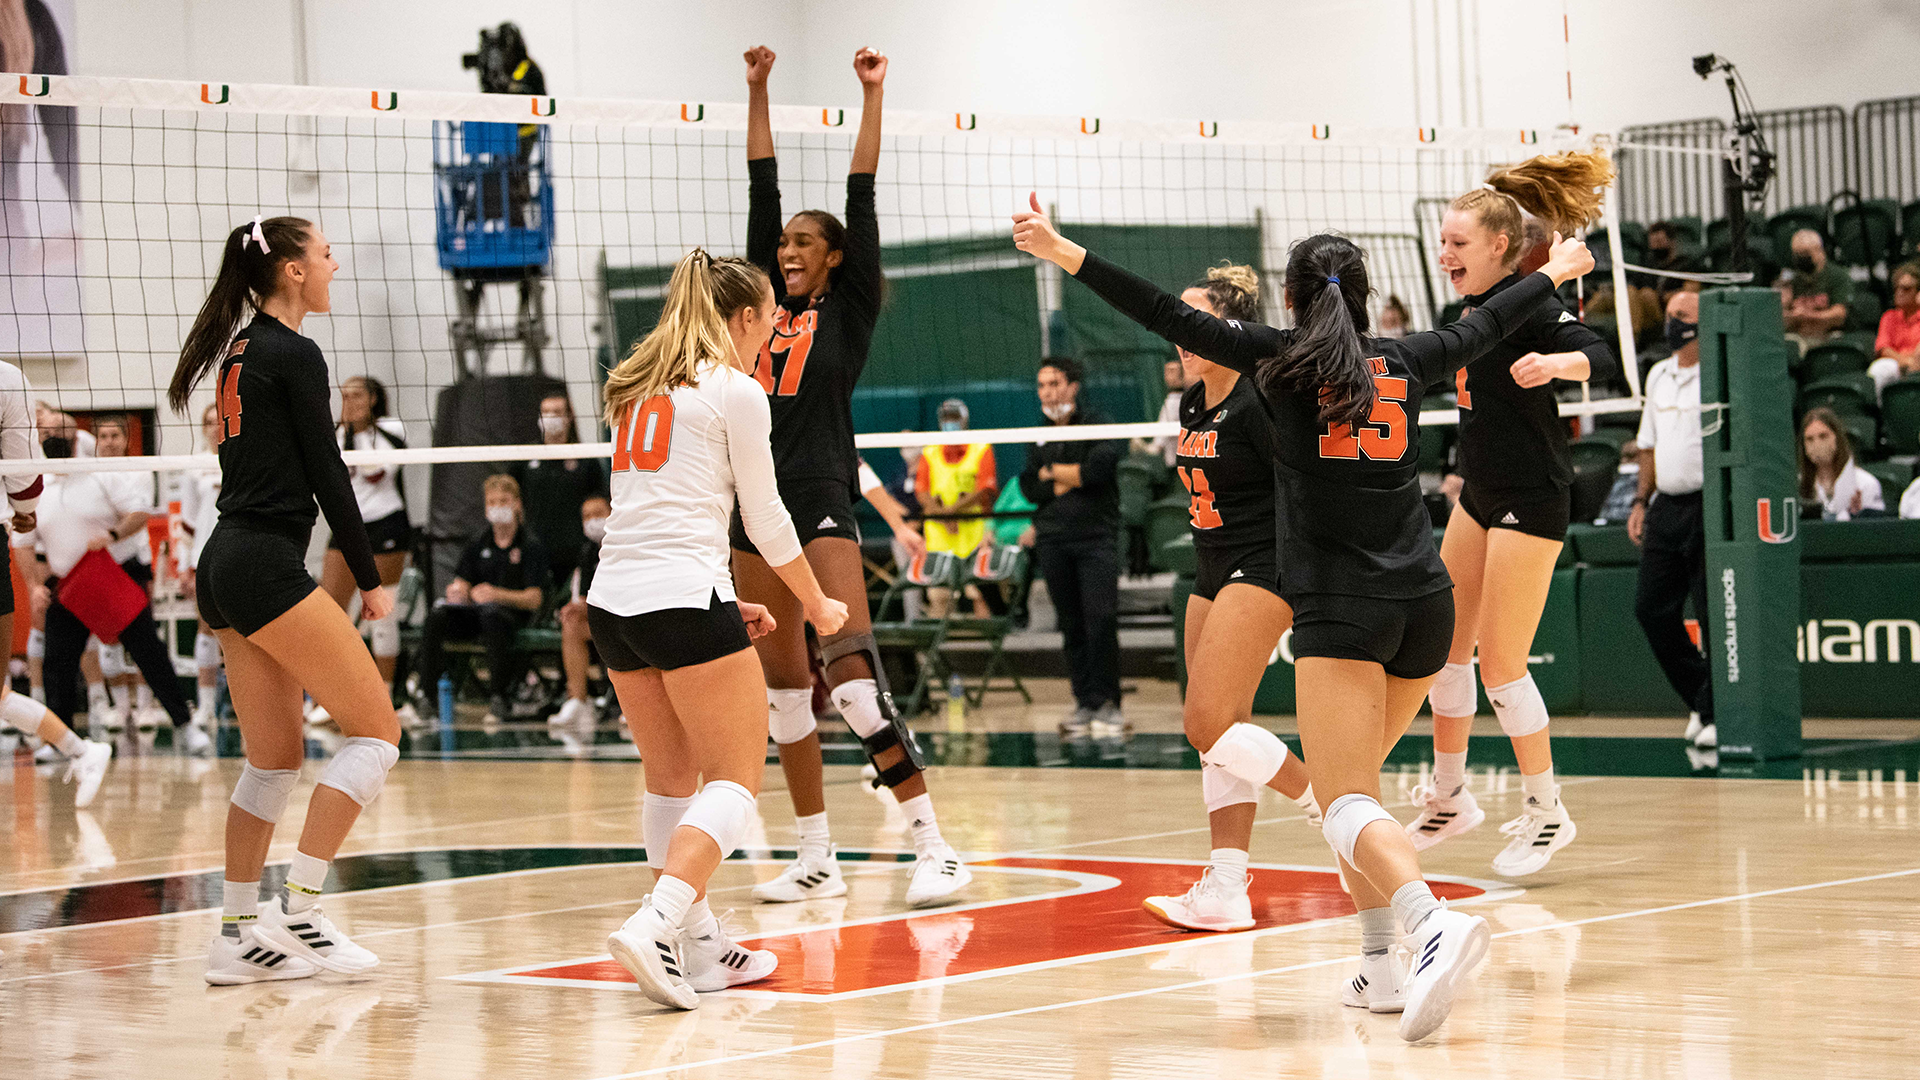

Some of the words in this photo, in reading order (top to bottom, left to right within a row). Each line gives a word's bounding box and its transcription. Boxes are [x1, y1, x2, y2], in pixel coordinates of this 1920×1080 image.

[19, 76, 49, 96] U
[201, 84, 229, 104] U
[371, 91, 398, 111] U
[531, 98, 556, 116] U
[681, 104, 704, 122] U
[822, 109, 844, 127] U
[956, 113, 976, 130] U
[1081, 118, 1099, 135] U
[1200, 122, 1218, 137] U
[1312, 125, 1330, 140] U
[1419, 128, 1435, 143] U
[1521, 130, 1537, 145] U
[1318, 376, 1408, 461] 15
[612, 394, 676, 473] 10
[1757, 498, 1797, 544] U
[973, 546, 1020, 580] U
[1721, 568, 1736, 619] sports
[1724, 619, 1740, 683] imports
